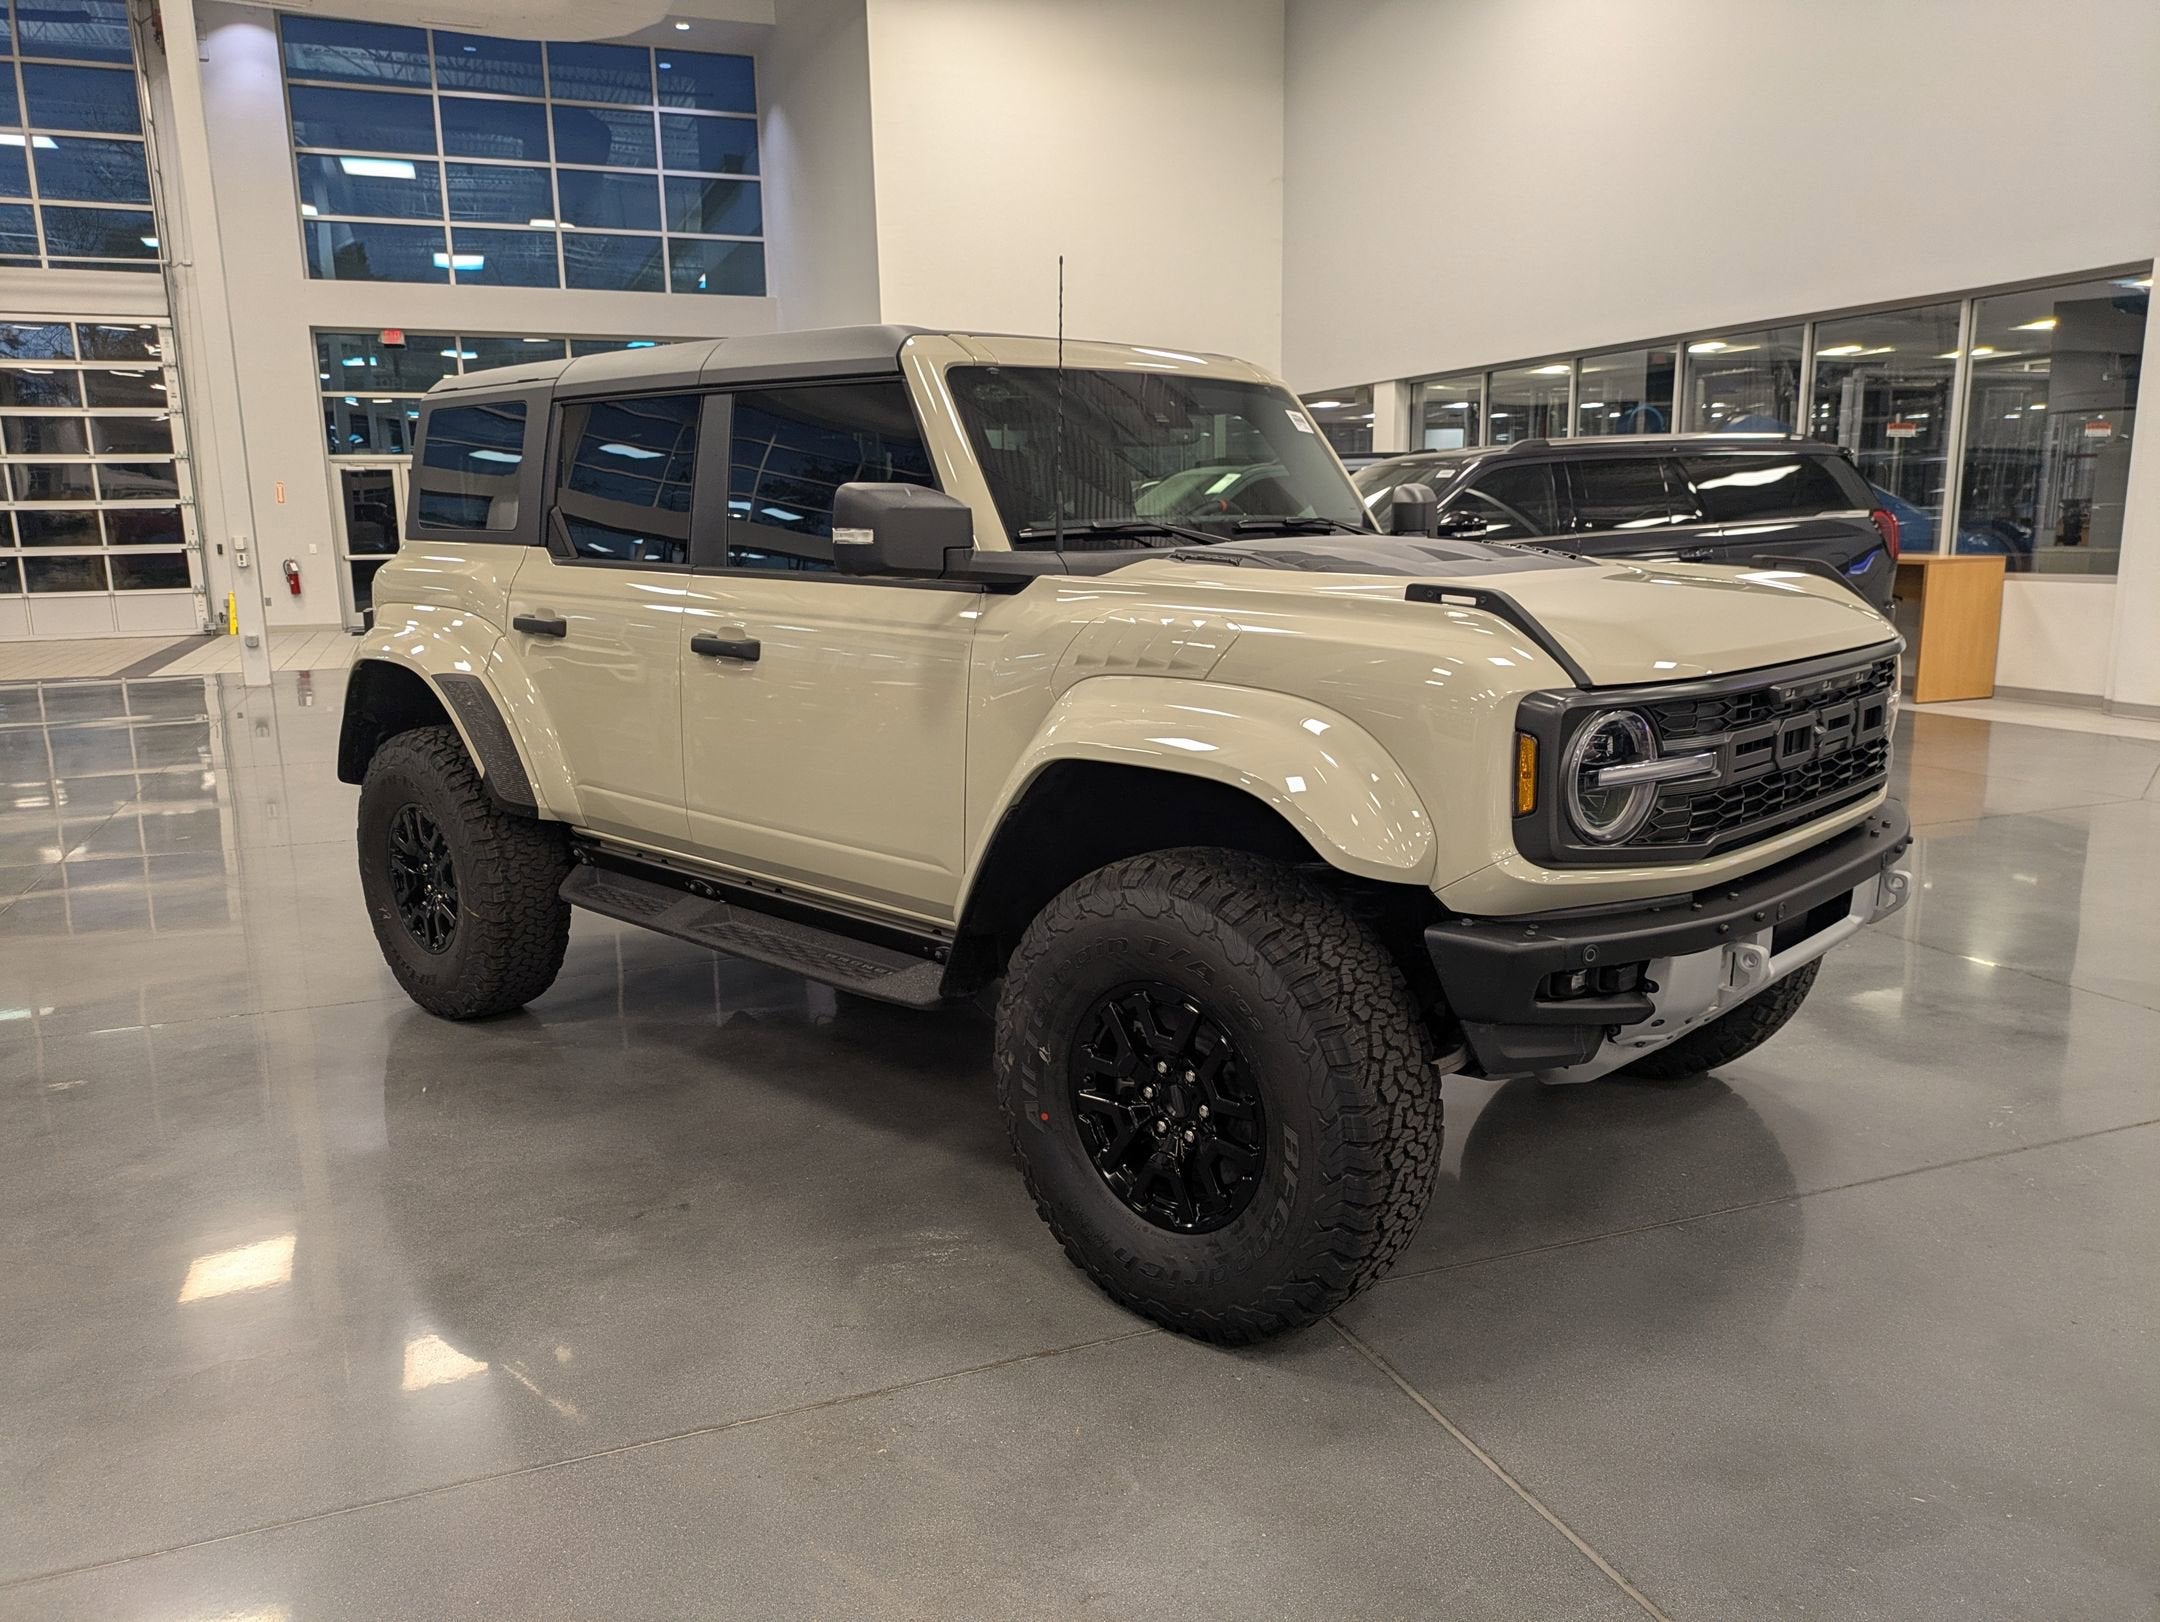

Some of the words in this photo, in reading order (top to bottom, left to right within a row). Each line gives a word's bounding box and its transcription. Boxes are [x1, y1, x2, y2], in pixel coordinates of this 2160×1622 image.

[1728, 690, 1888, 784] FORD
[1144, 935, 1217, 985] T/A
[1112, 1122, 1299, 1289] BFGoodrich
